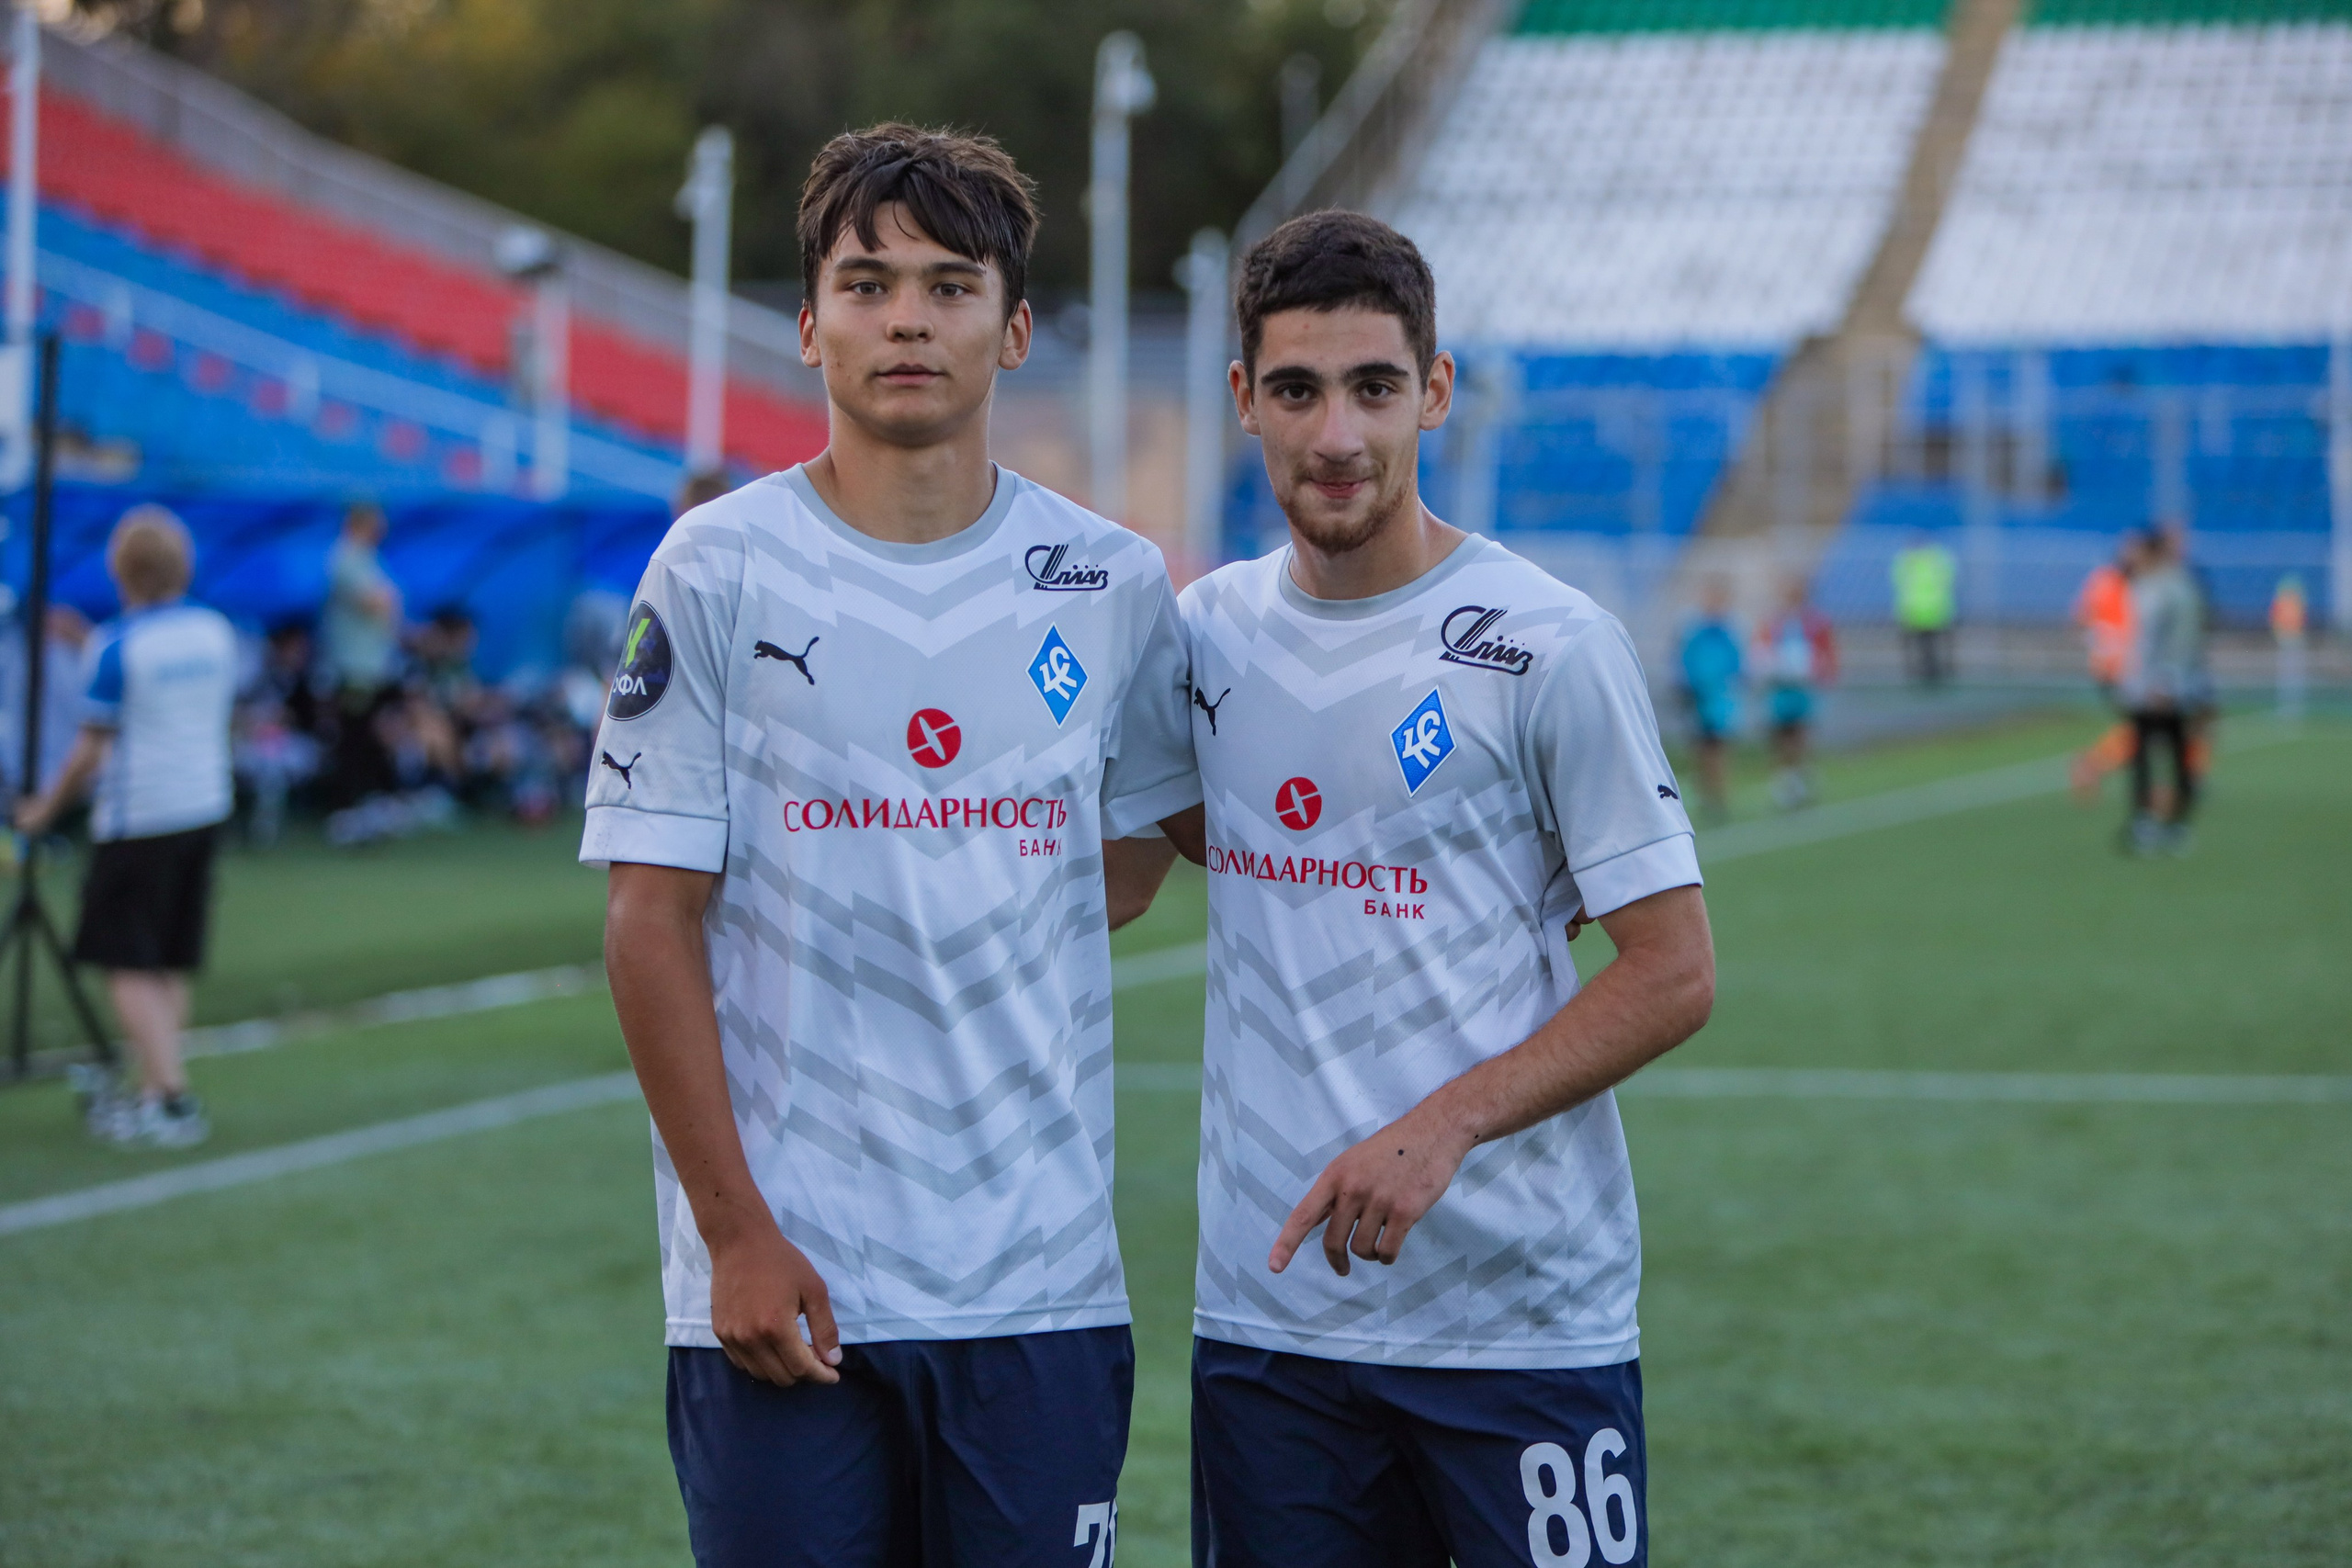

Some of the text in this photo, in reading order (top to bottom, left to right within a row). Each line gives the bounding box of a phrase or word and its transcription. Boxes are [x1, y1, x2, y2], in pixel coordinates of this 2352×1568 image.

[783, 797, 1067, 832] СОЛИДАРНОСТЬ
[1208, 845, 1428, 894] СОЛИДАРНОСТЬ
[1363, 899, 1425, 919] БАНК
[1520, 1427, 1637, 1568] 86
[1073, 1498, 1118, 1568] 7
